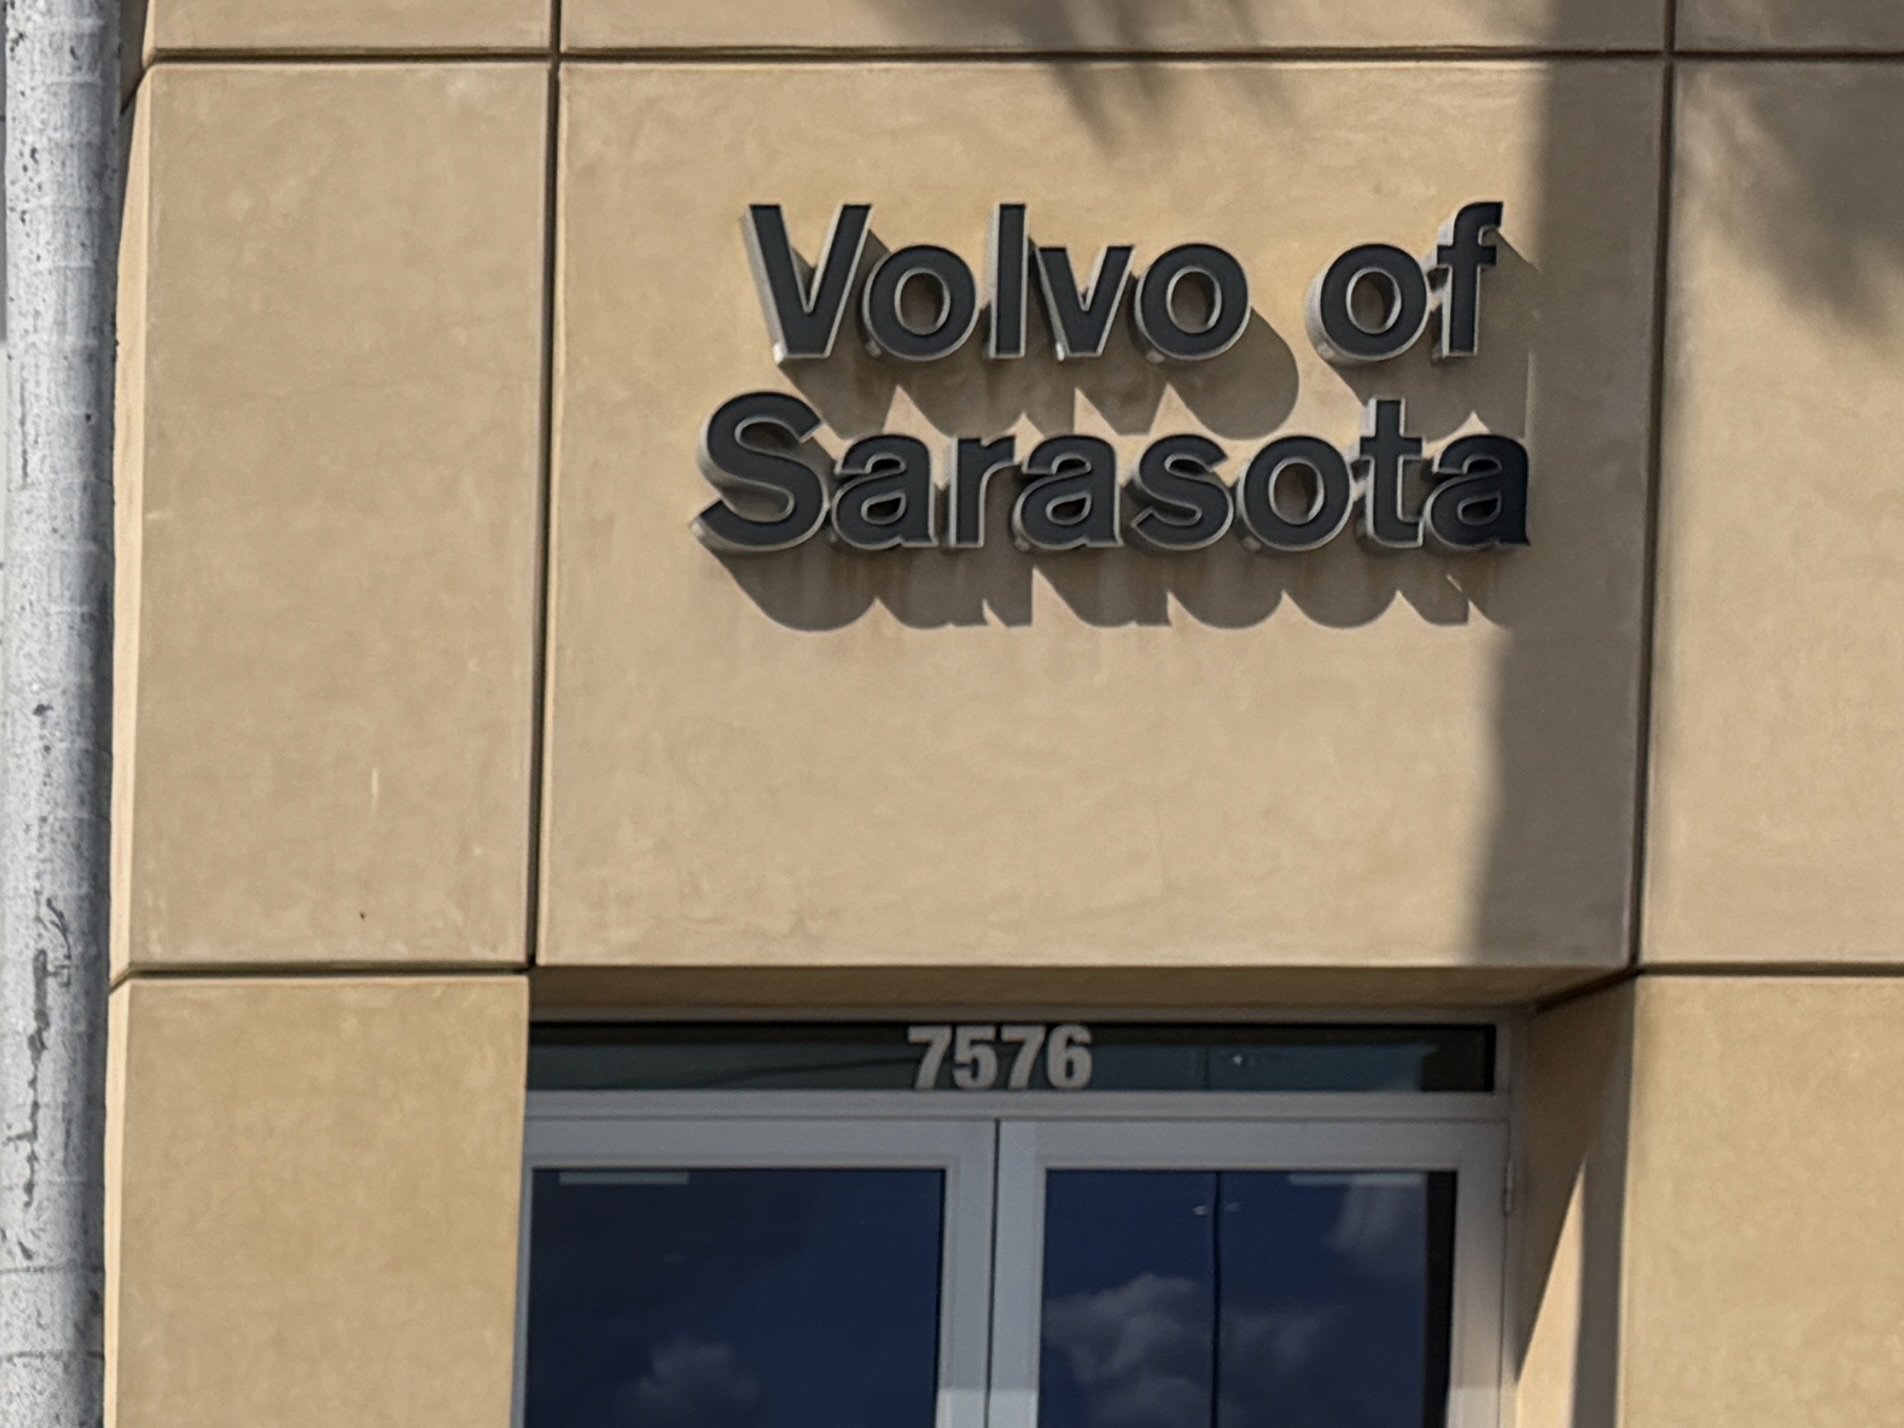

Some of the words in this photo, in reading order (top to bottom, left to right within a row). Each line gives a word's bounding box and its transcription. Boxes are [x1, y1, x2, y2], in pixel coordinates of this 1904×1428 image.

[742, 202, 1253, 364] Volvo
[1309, 201, 1503, 366] of
[693, 390, 1530, 553] Sarasota
[908, 1024, 1092, 1090] 7576
